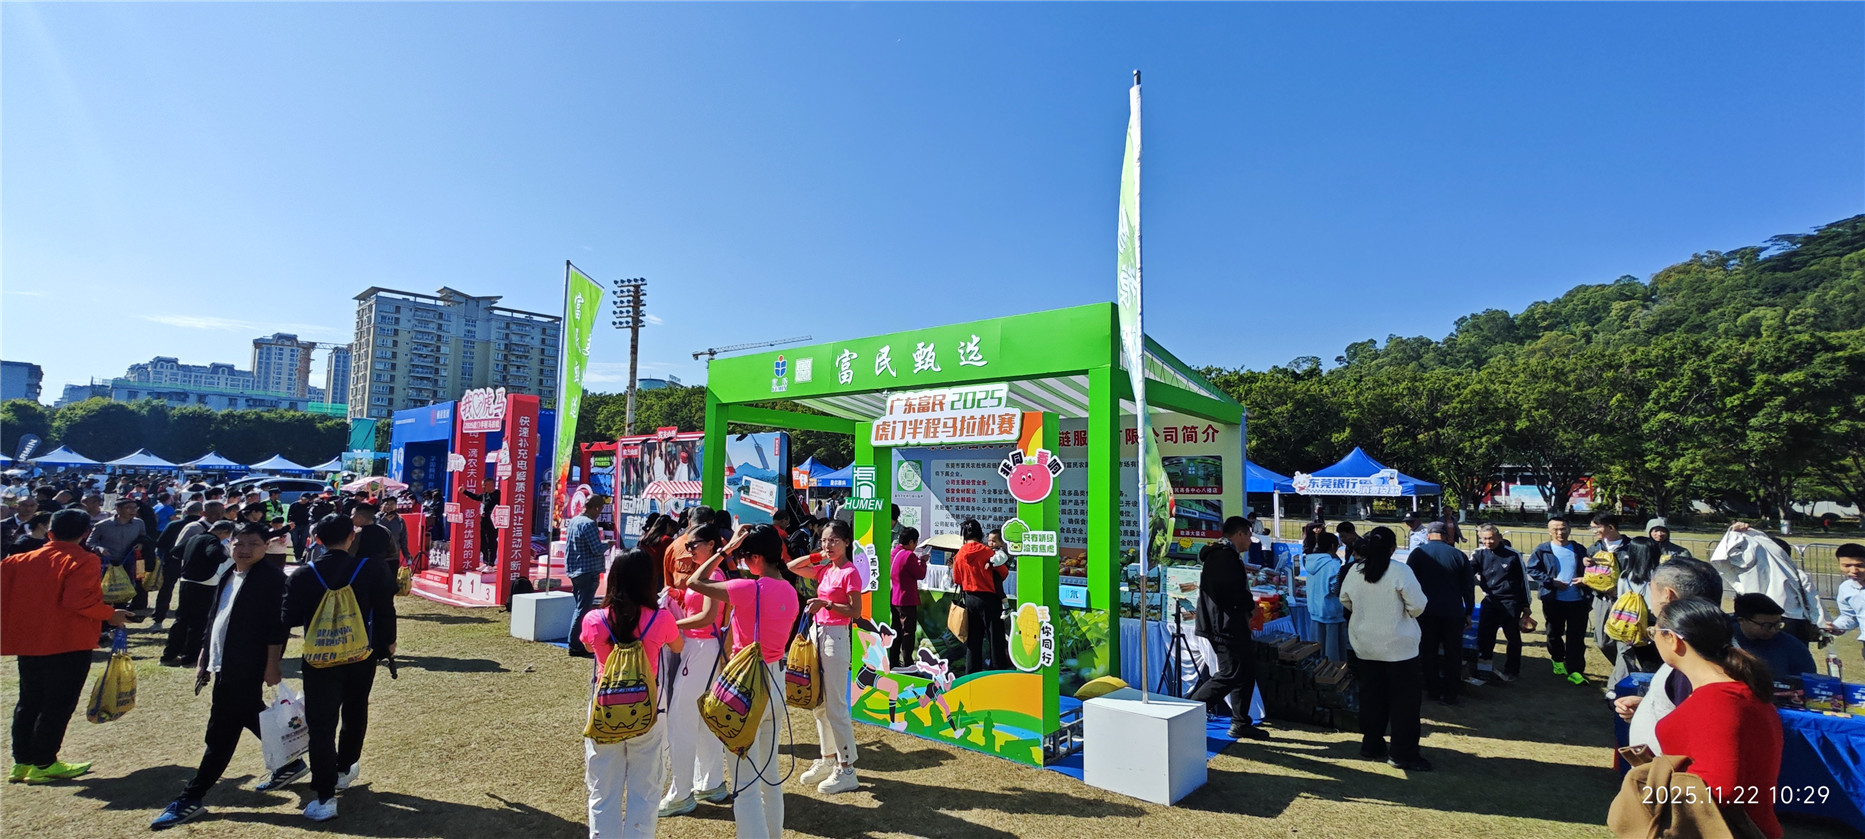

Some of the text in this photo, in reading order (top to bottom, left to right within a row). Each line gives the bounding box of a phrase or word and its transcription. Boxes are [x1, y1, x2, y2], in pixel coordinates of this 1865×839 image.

[835, 334, 988, 385] 富民甄选
[889, 389, 1004, 415] 广东富民 2025
[874, 413, 1017, 441] 虎门半程马拉松赛
[1119, 428, 1139, 445] 限
[1308, 478, 1358, 489] 东莞银行
[844, 498, 884, 510] HUMEN
[1059, 499, 1088, 507] 副产品手
[462, 509, 476, 569] 都有优质的水
[457, 579, 491, 601] 2 1 3
[1039, 608, 1053, 664] 玉你同行
